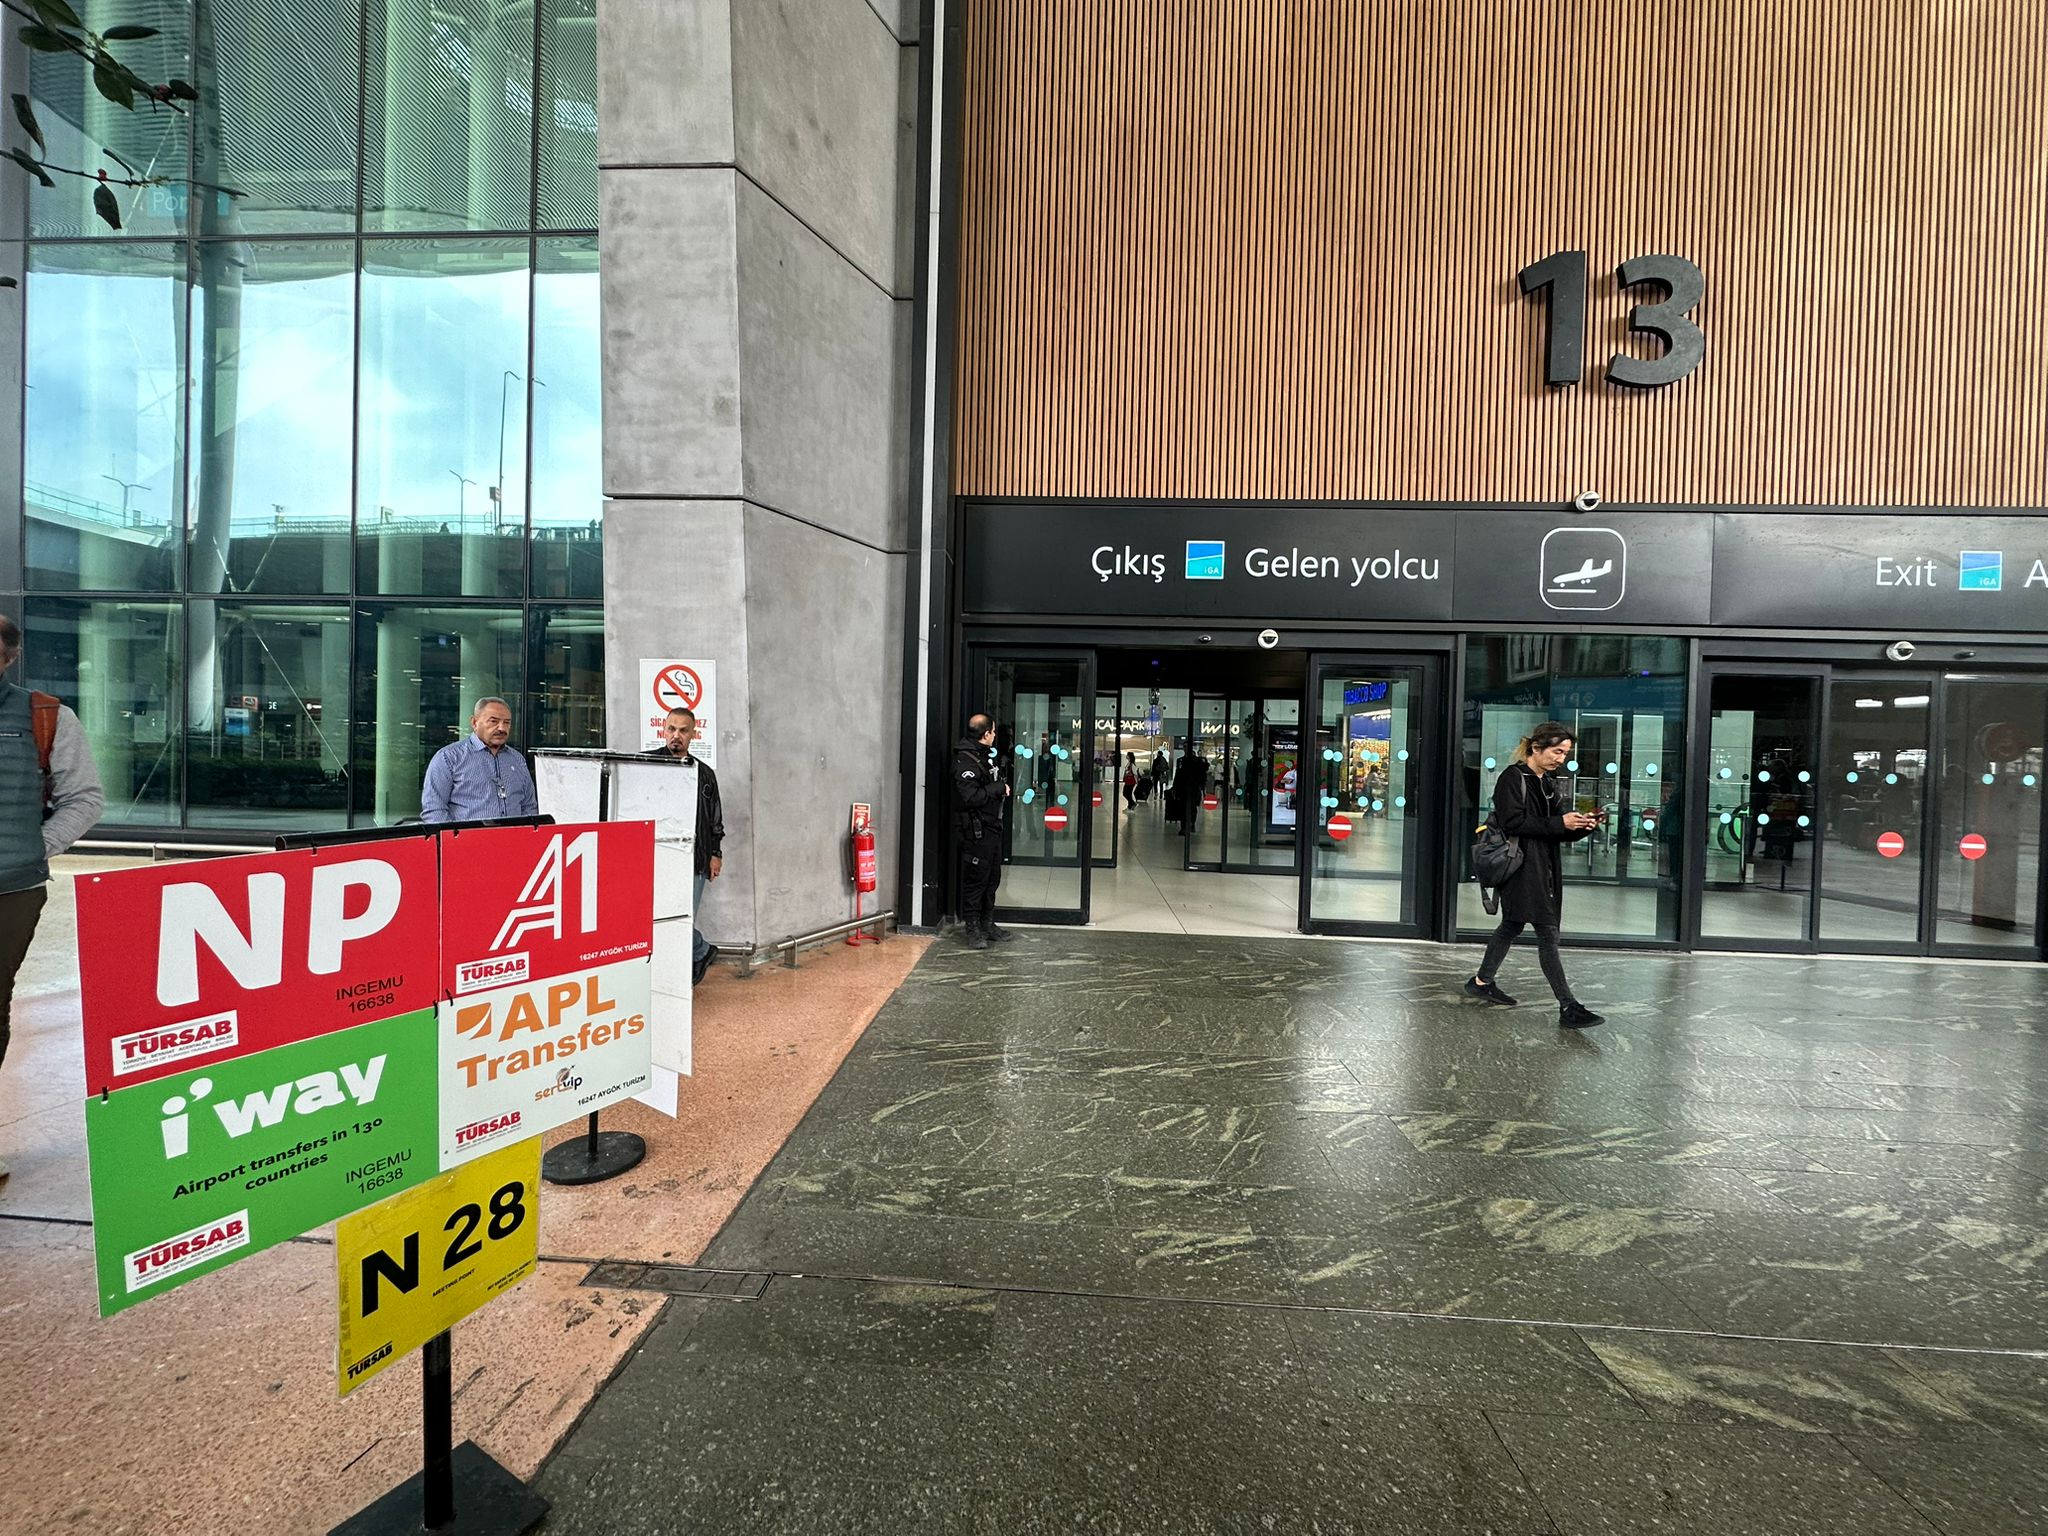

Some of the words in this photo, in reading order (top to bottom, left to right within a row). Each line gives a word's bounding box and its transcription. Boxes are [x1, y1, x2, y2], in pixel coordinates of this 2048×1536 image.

[1518, 250, 1704, 388] 13
[1091, 545, 1166, 583] Çıkış
[1245, 547, 1339, 580] Gelen
[1350, 549, 1440, 587] yolcu
[1875, 556, 1938, 587] Exit
[488, 831, 598, 951] A1
[157, 858, 402, 1007] NP
[336, 975, 404, 1000] INGEMU
[348, 992, 395, 1013] 16638
[498, 975, 616, 1042] APL
[457, 1013, 645, 1089] Transfers
[172, 1164, 246, 1200] Airport
[249, 1135, 328, 1172] transfers
[332, 1129, 347, 1143] in
[245, 1152, 328, 1192] countries
[345, 1148, 413, 1184] INGEMU
[357, 1167, 404, 1194] 16638
[362, 1231, 419, 1318] N
[443, 1181, 526, 1271] 28
